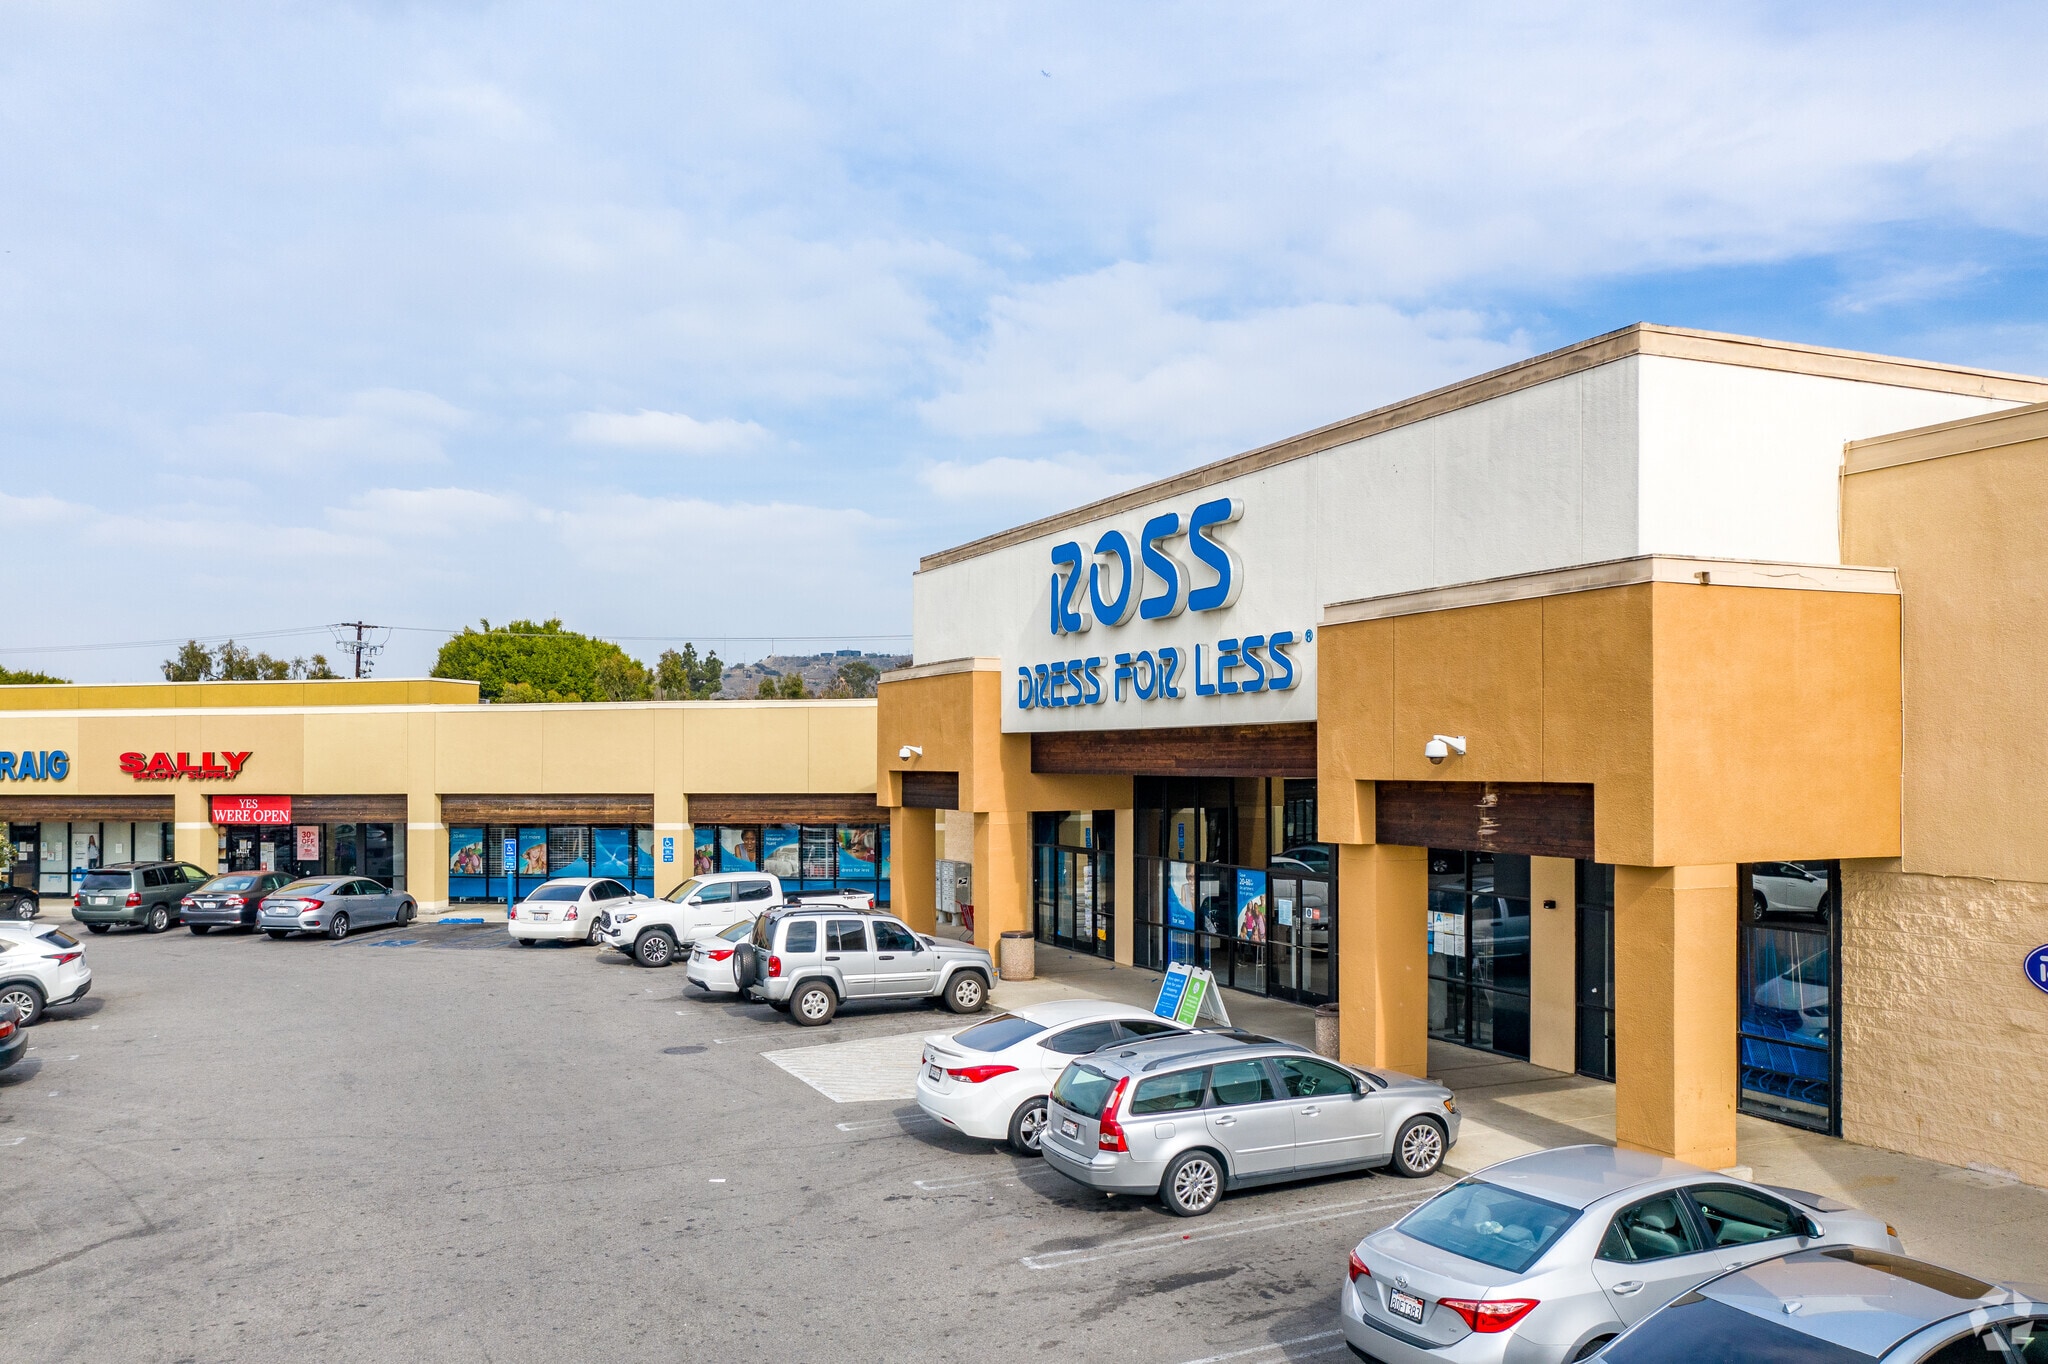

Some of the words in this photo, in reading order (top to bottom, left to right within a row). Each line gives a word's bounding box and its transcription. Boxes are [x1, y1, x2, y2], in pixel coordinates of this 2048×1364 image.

[1051, 497, 1238, 635] ROSS
[1018, 656, 1105, 709] DRESS
[1114, 647, 1182, 702] FOR
[1195, 631, 1298, 697] LESS
[119, 751, 252, 772] SALLY
[132, 771, 181, 780] BEAUTY
[187, 771, 238, 780] SUPPLY
[239, 799, 258, 808] YES
[213, 810, 250, 822] WERE
[253, 810, 289, 822] OPEN
